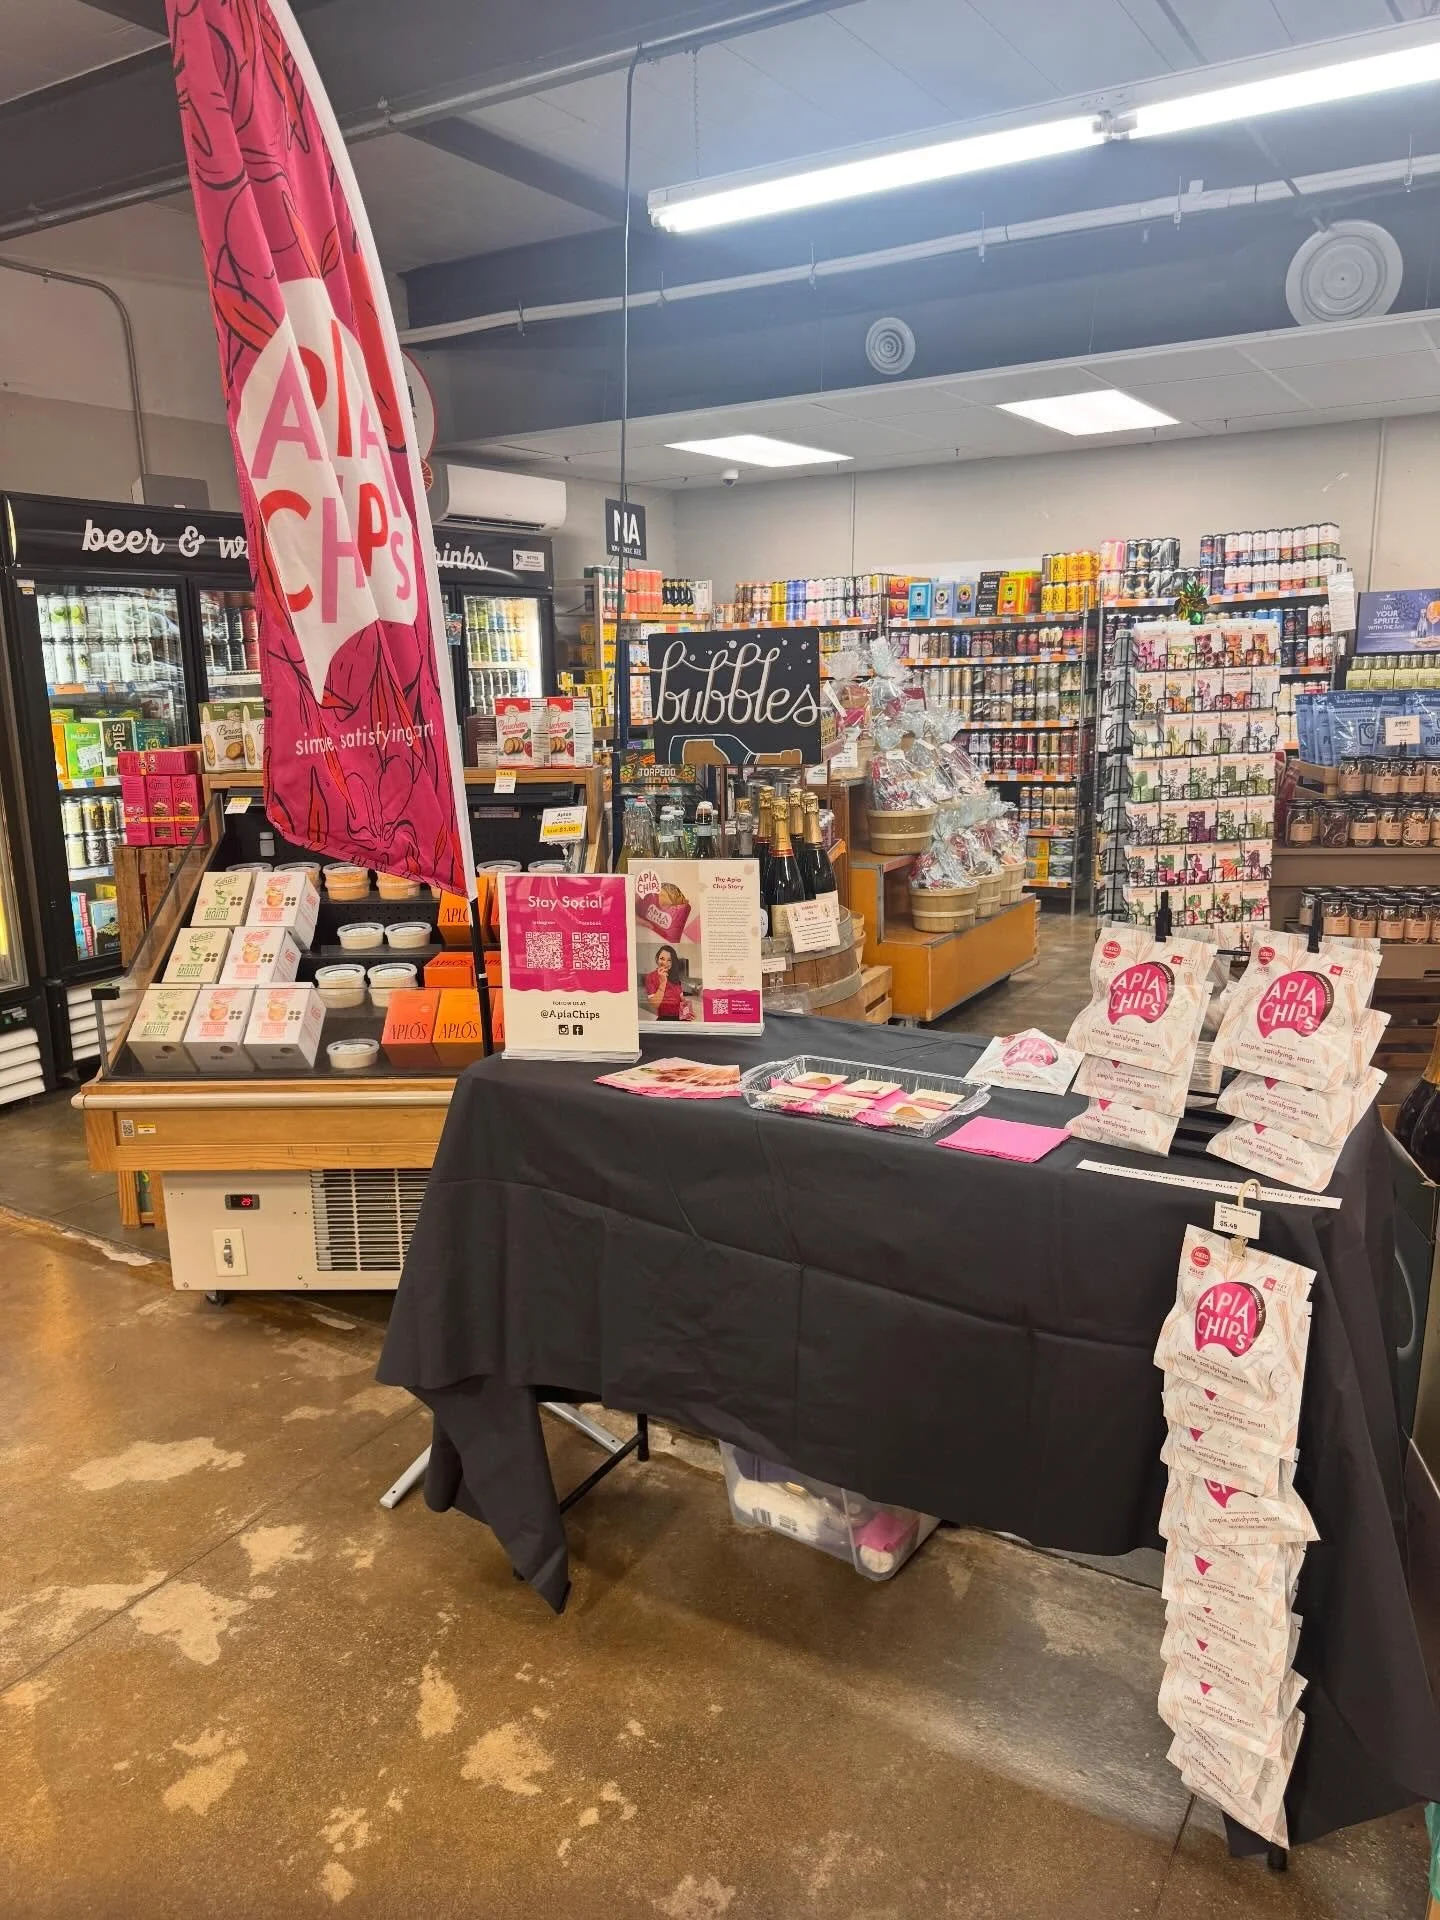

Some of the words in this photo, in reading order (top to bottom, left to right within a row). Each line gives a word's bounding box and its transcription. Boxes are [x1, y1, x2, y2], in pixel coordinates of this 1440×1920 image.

[82, 519, 164, 554] beer
[178, 525, 206, 557] &
[613, 509, 641, 546] NA
[259, 476, 411, 624] CHPS
[652, 641, 833, 726] bubbles
[639, 768, 676, 777] TORPEDO
[637, 883, 661, 895] CHIPS
[638, 872, 658, 884] APIA
[727, 877, 742, 885] Apia
[528, 896, 559, 911] Stay
[562, 896, 603, 909] Social
[1113, 968, 1161, 1001] APIA
[1265, 978, 1317, 1015] APIA
[540, 1009, 600, 1020] @ApiaChips
[1110, 986, 1160, 1017] CHIPS
[1259, 1002, 1315, 1031] CHIPS
[1200, 1291, 1250, 1334] APIA
[1197, 1312, 1249, 1350] CHIPS
